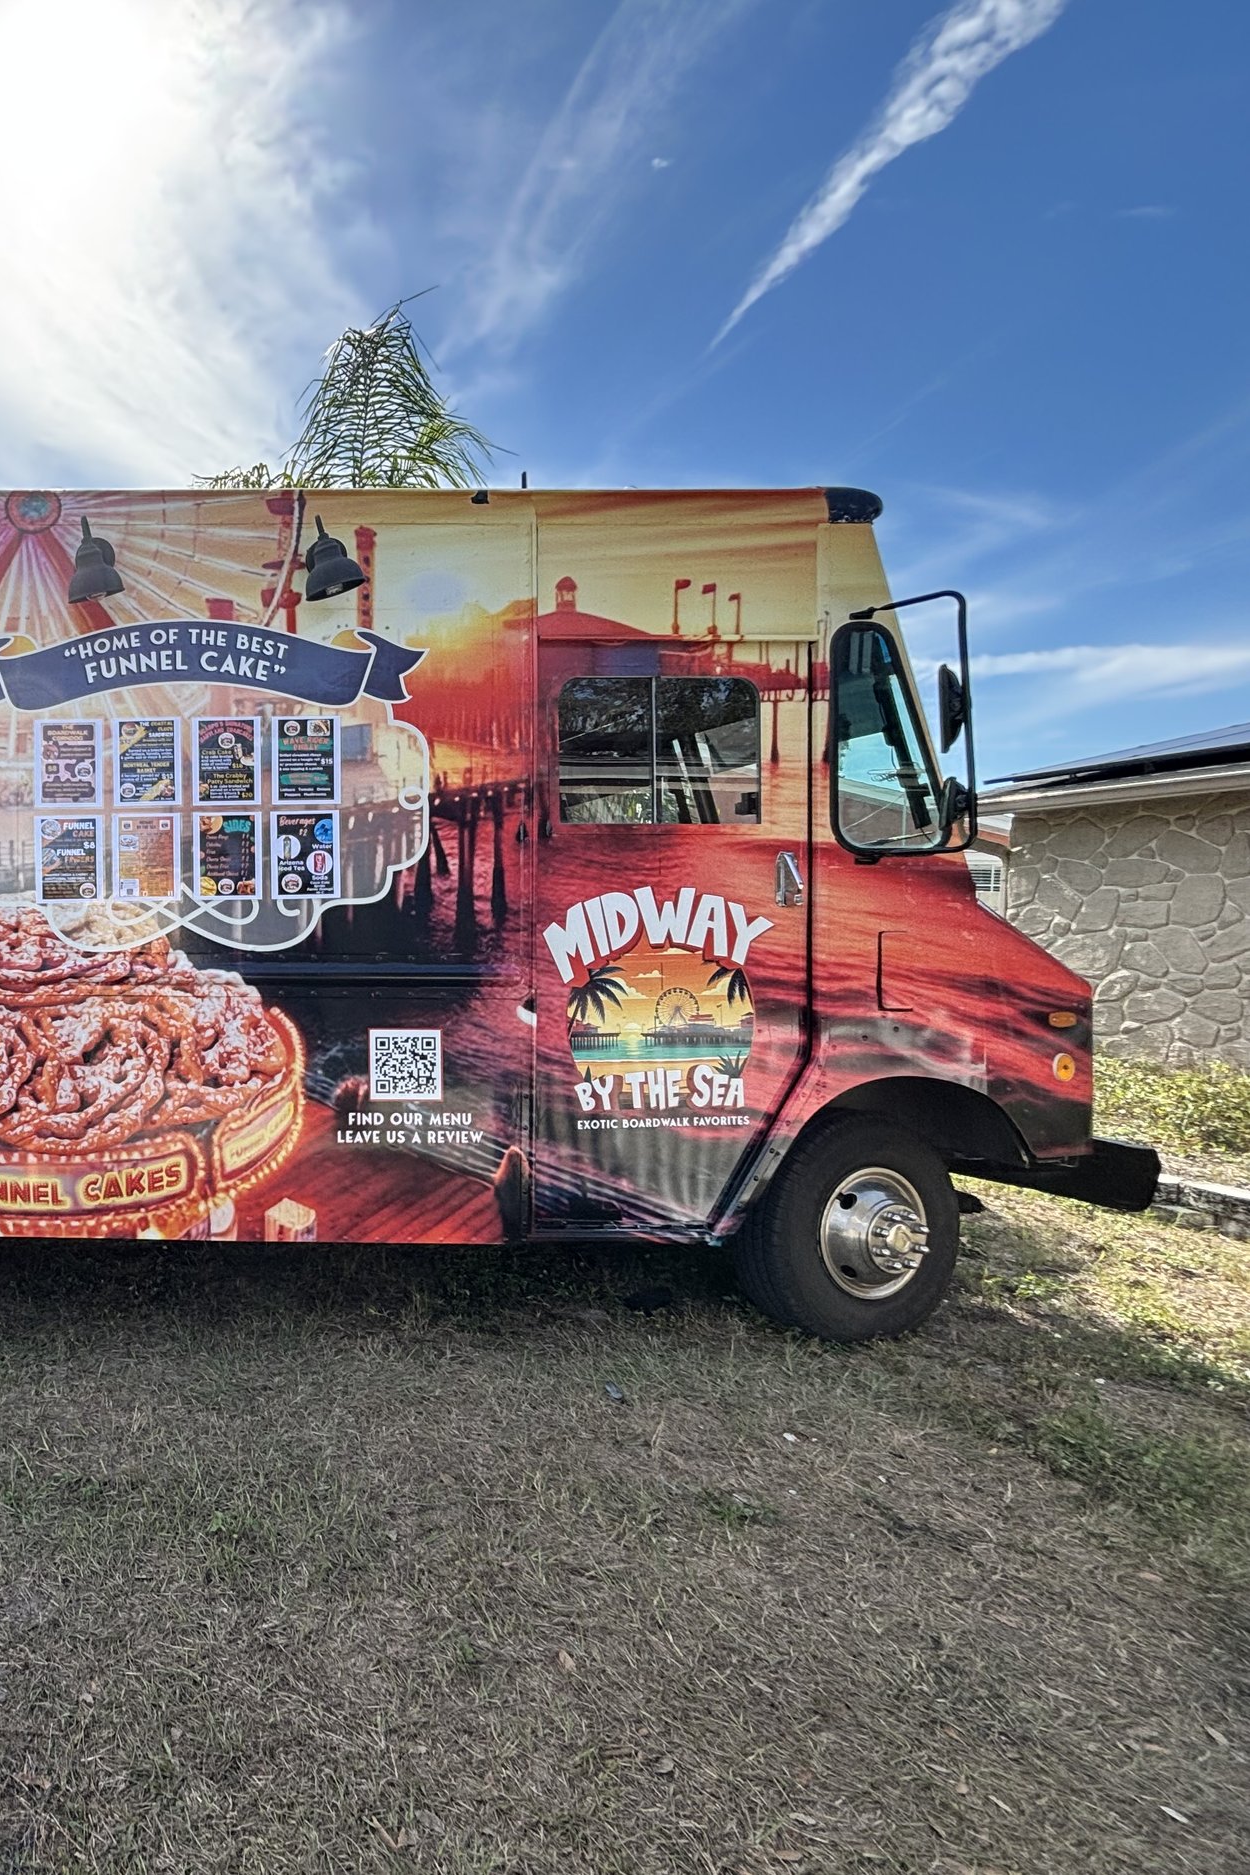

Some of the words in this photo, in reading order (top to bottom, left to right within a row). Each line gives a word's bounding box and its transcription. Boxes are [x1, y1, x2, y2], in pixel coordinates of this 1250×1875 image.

[150, 628, 179, 645] OF
[188, 628, 228, 647] THE
[236, 633, 289, 660] BEST
[84, 650, 188, 684] FUNNEL
[223, 819, 251, 833] SIDES
[279, 816, 316, 827] Beverages
[542, 886, 776, 984] MIDWAY
[574, 1075, 614, 1112] BY
[625, 1068, 682, 1110] THE
[690, 1064, 746, 1108] SEA
[348, 1112, 384, 1126] FIND
[390, 1112, 423, 1126] OUR
[429, 1112, 472, 1126] MENU
[577, 1120, 618, 1130] EXOTIC
[622, 1117, 690, 1129] BOARDWALK
[694, 1116, 750, 1126] FAVORITES
[337, 1130, 380, 1144] LEAVE
[386, 1130, 406, 1144] US
[412, 1130, 422, 1144] A
[427, 1130, 484, 1144] REVIEW
[81, 1160, 183, 1202] CAKES
